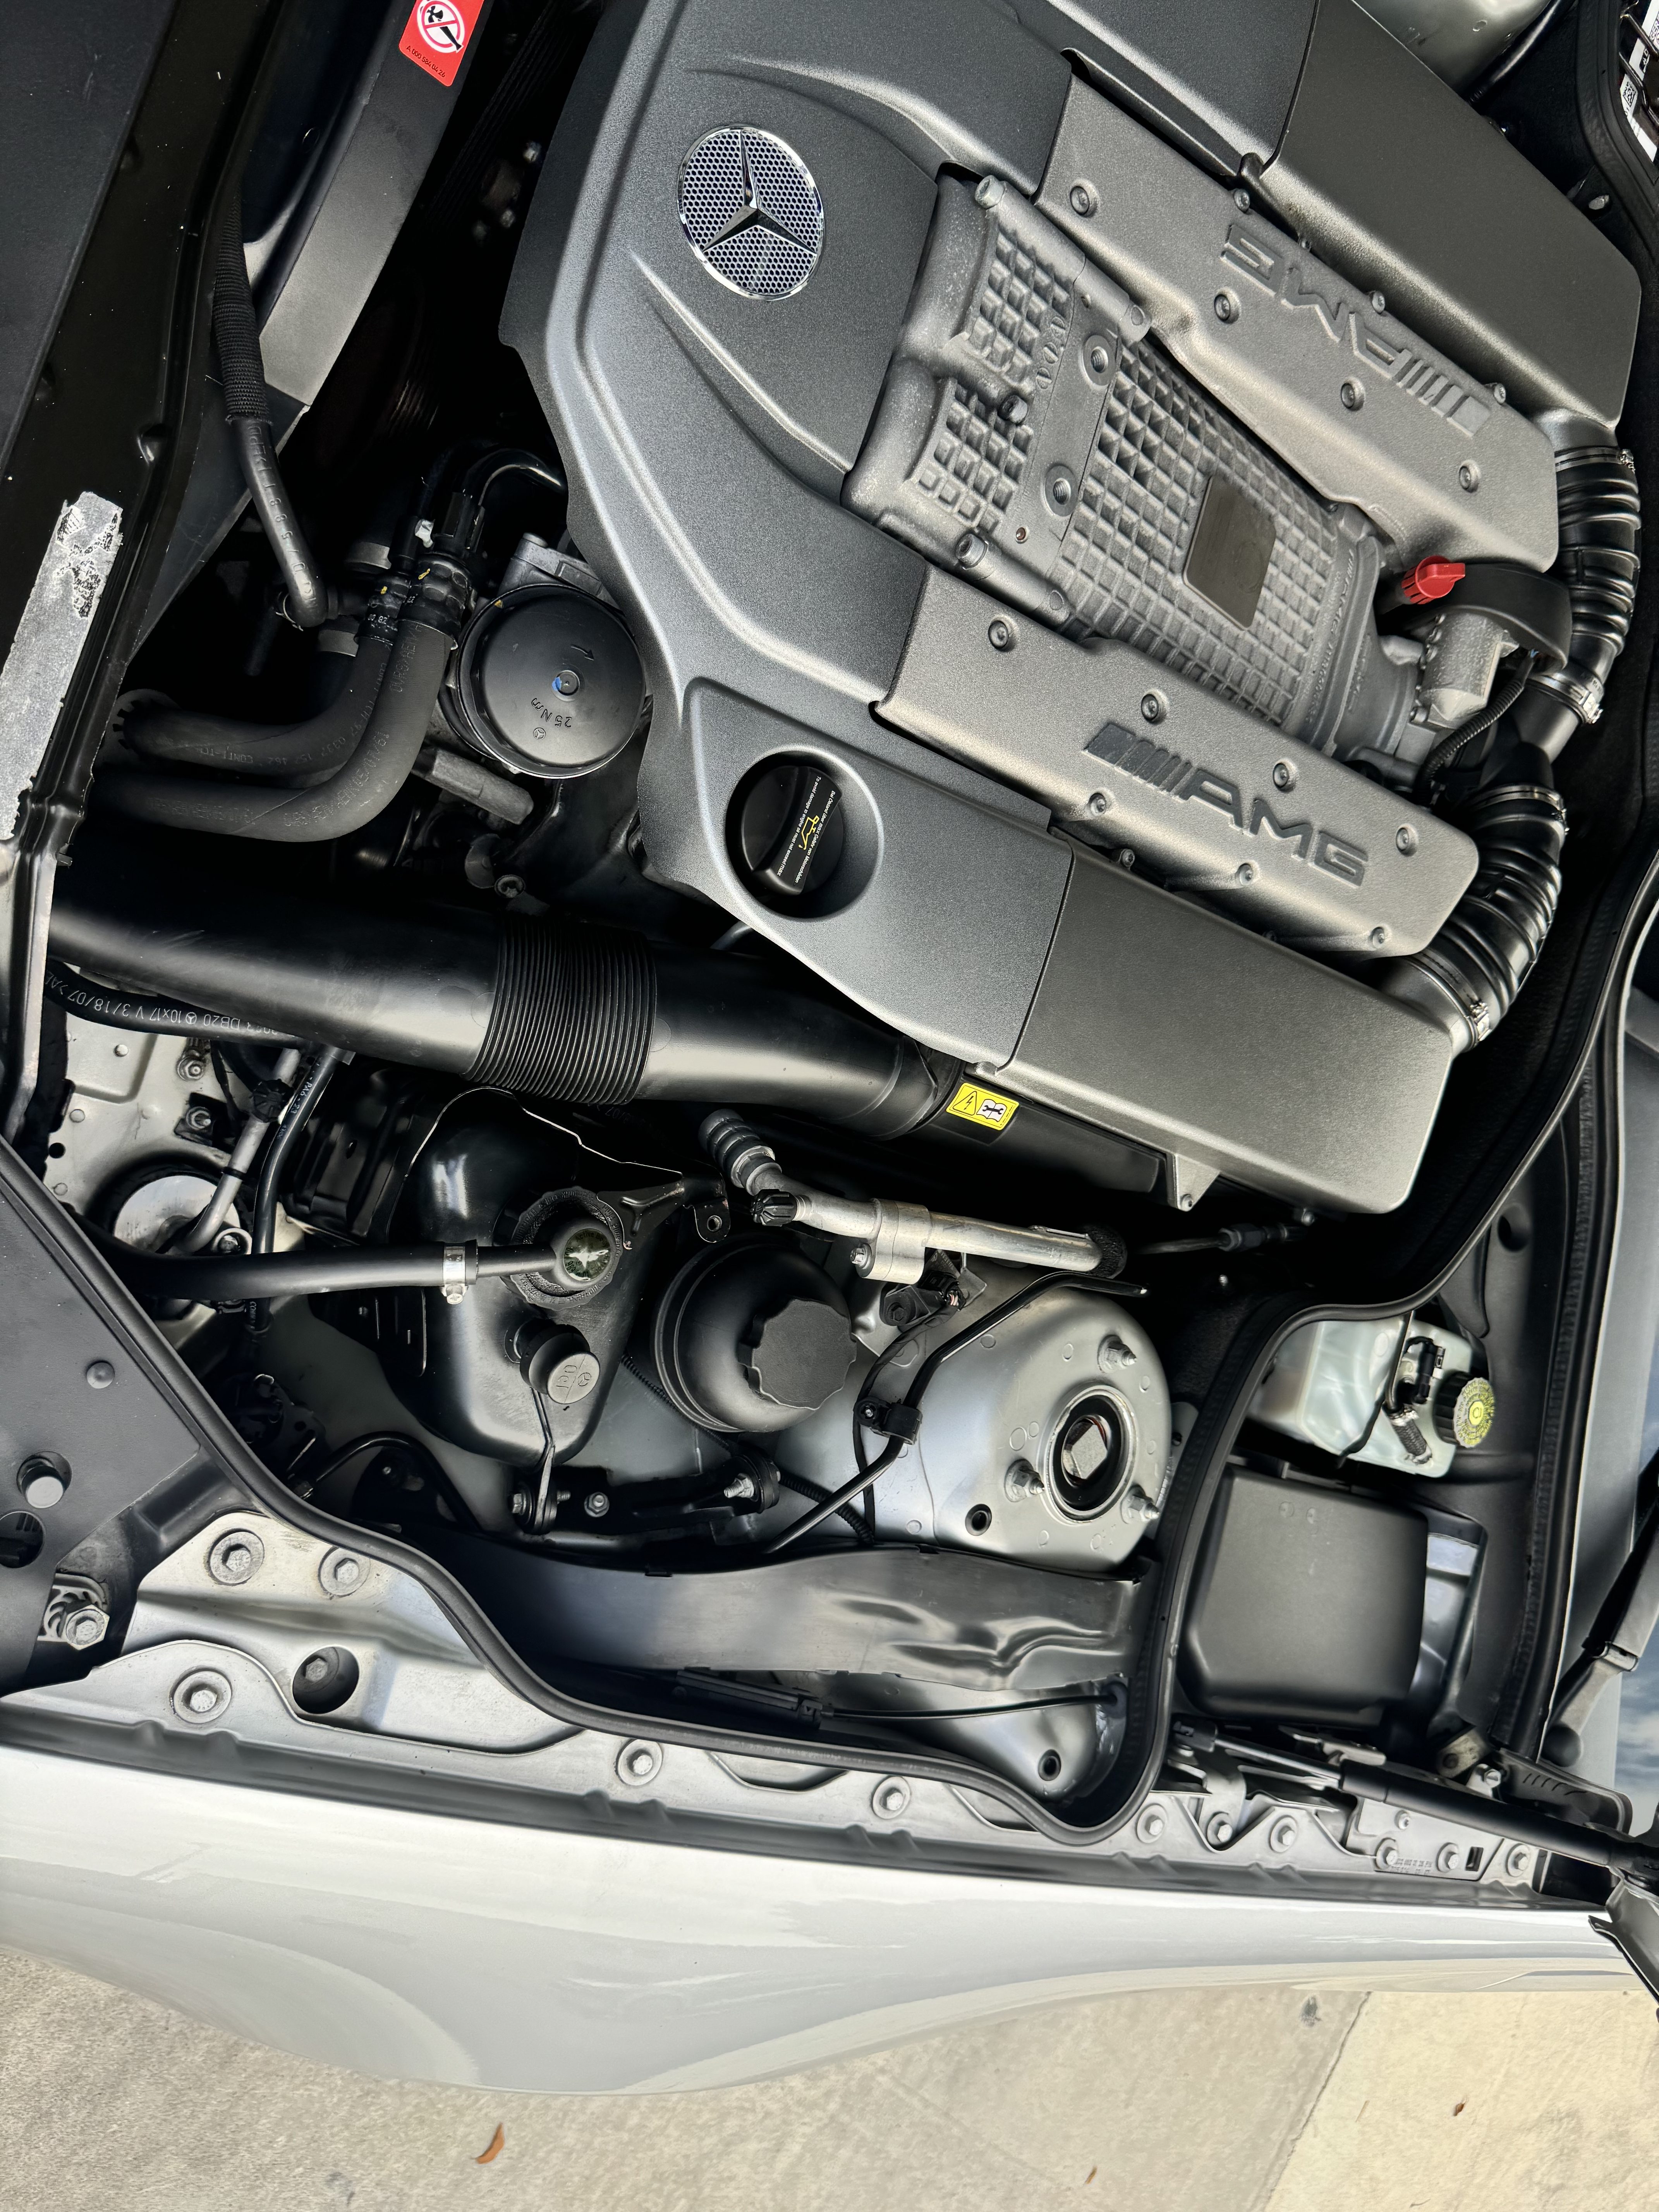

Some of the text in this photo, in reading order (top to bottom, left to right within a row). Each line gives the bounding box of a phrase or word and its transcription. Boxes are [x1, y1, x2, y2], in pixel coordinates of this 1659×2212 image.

[412, 49, 421, 59] 000
[422, 56, 431, 67] 584
[431, 64, 438, 72] 04
[531, 697, 572, 728] 25 Nm
[1178, 768, 1368, 888] AMG
[203, 1013, 240, 1030] DB20
